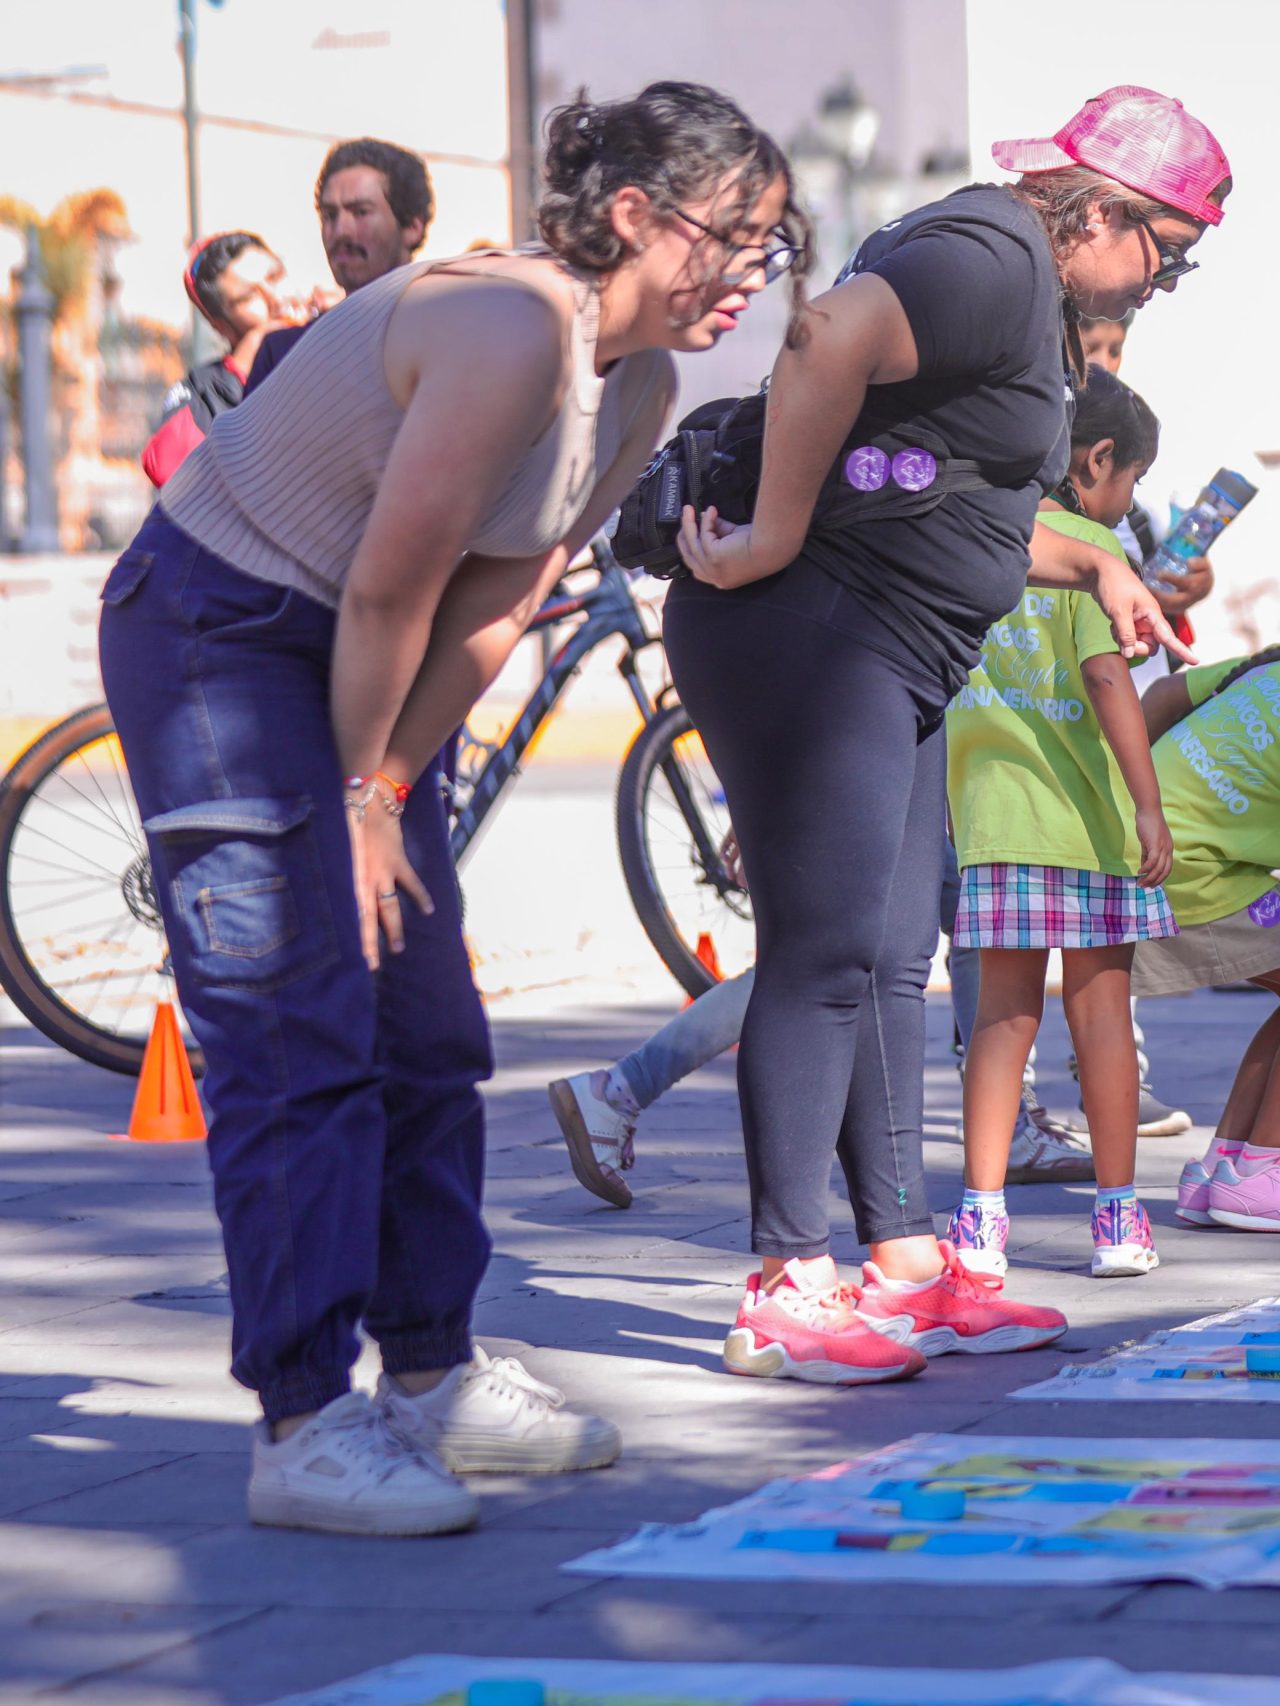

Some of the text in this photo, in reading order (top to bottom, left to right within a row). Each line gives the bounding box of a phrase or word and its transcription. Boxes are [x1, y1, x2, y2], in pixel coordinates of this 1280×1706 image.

[664, 476, 678, 516] KAMPAK
[1024, 593, 1055, 619] DE
[959, 685, 1084, 721] ANIVERRIO
